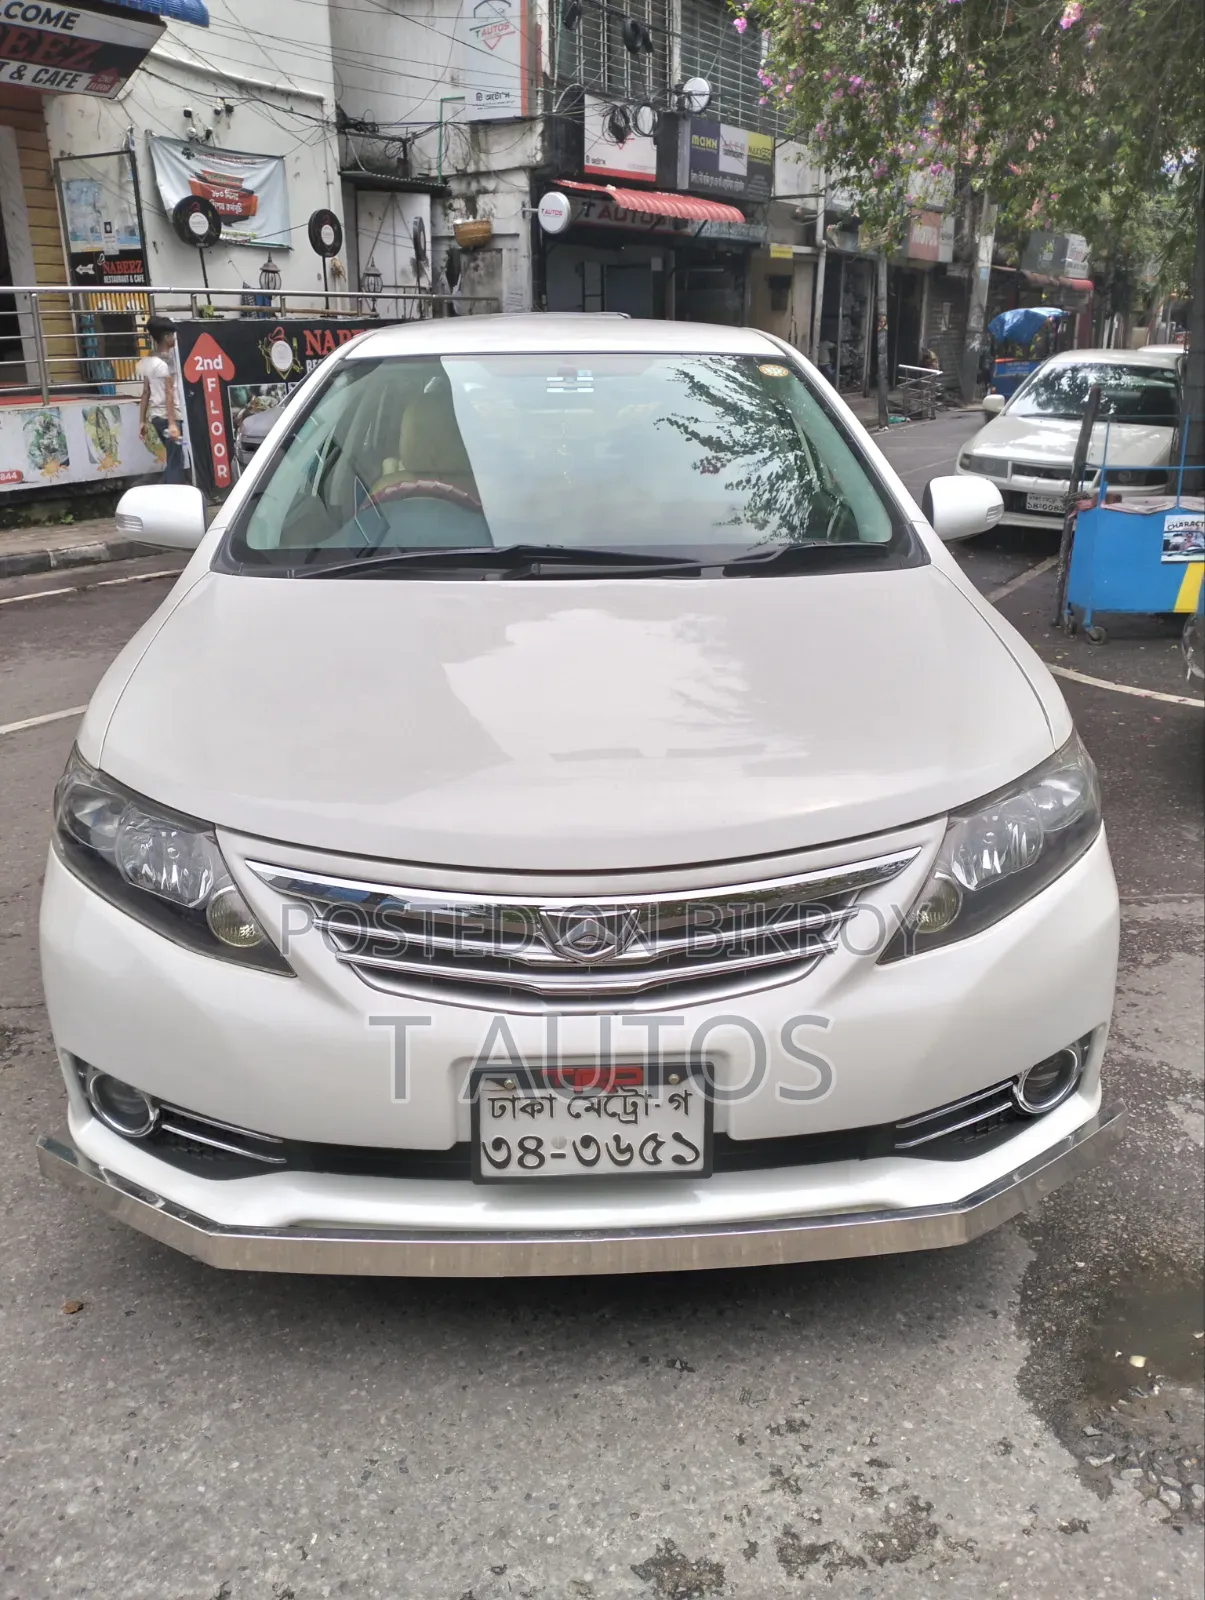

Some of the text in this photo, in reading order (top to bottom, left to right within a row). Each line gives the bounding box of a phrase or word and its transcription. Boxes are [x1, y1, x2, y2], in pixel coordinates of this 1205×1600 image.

[0, 1, 80, 31] COME
[481, 22, 510, 36] AUTOS
[0, 26, 104, 70] EEZ
[9, 65, 27, 80] &
[31, 68, 82, 89] CAFE
[544, 209, 563, 217] AUTOS
[103, 260, 143, 275] NABEEZ
[134, 274, 145, 282] CAFE
[194, 355, 223, 371] 2nd
[488, 1093, 555, 1119] ঢাকা
[482, 1131, 700, 1170] ৩৪-৩৬৫১
